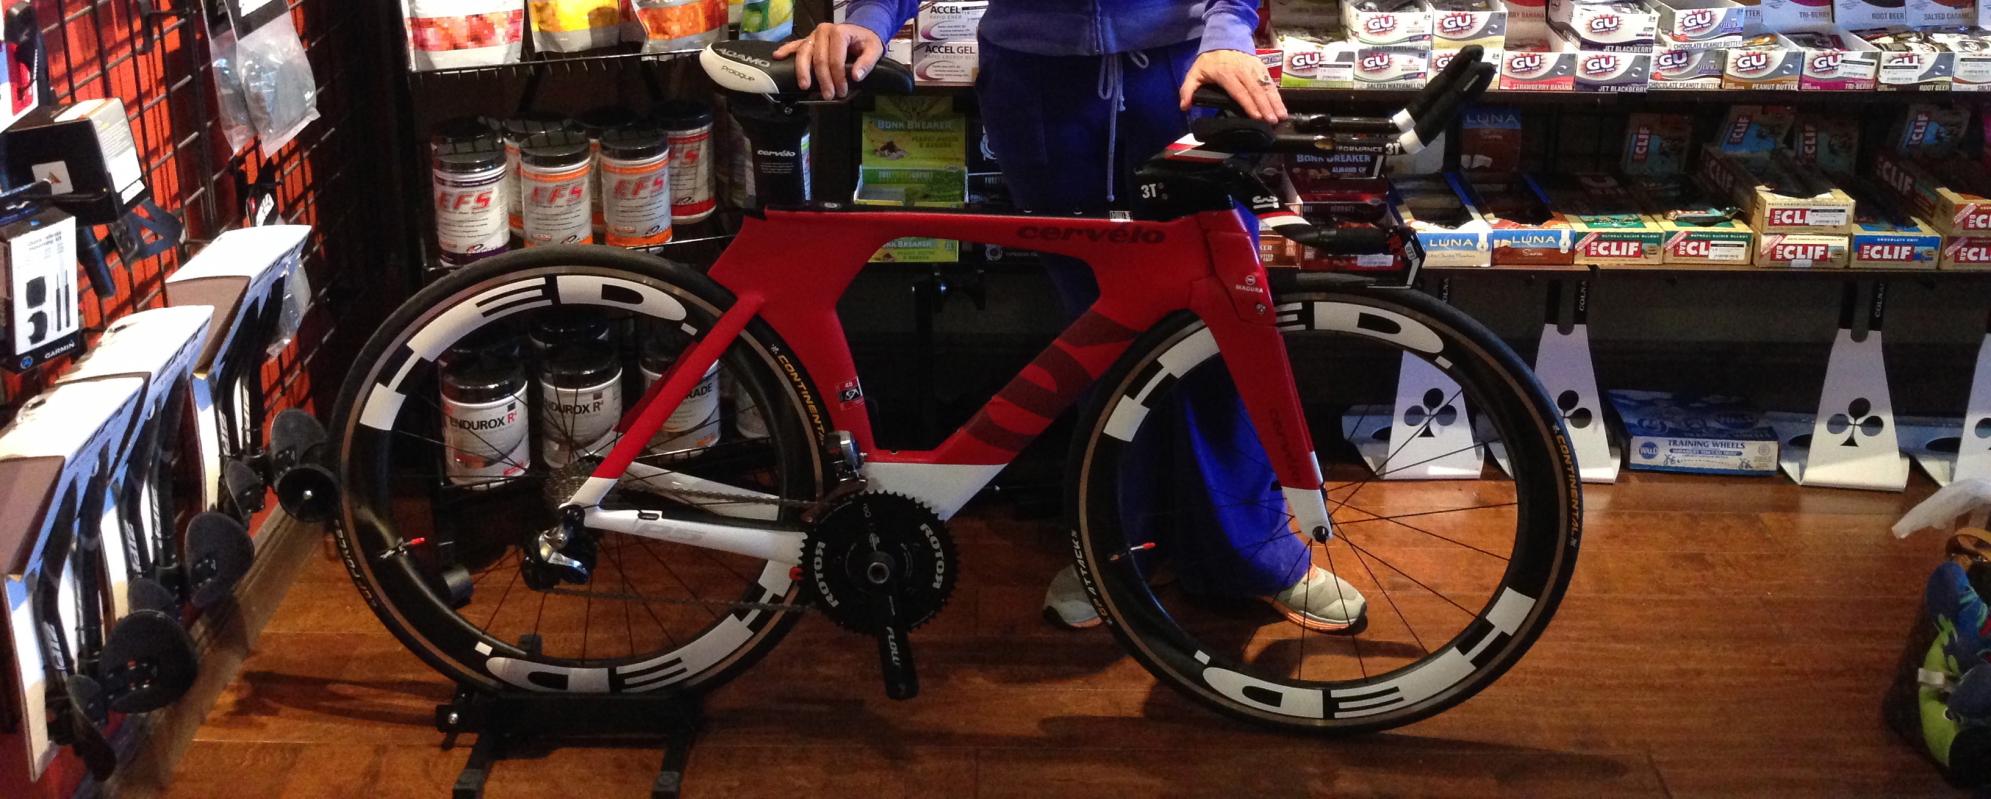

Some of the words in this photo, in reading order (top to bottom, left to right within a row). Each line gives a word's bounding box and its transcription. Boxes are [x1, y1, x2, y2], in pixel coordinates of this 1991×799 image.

[930, 6, 960, 14] ACCEL
[1745, 9, 1761, 17] TTER
[1889, 12, 1904, 20] BEER
[1366, 15, 1395, 31] GU
[1443, 14, 1472, 30] GU
[1591, 16, 1618, 30] GU
[1683, 12, 1712, 28] GU
[925, 45, 956, 54] ACCEL
[957, 46, 976, 55] GEL
[1614, 45, 1651, 53] BLACKBERRY
[1674, 42, 1701, 50] CHOCOLATE
[715, 47, 771, 68] ADAMO
[1291, 52, 1321, 67] GU
[1363, 53, 1390, 68] GU
[1512, 55, 1541, 70] GU
[1586, 57, 1616, 70] GU
[1658, 51, 1688, 66] GU
[1737, 54, 1766, 69] GU
[1813, 54, 1842, 69] GU
[1610, 85, 1647, 93] BLACKBERRY
[878, 119, 904, 129] BONK
[907, 119, 952, 129] BREAKER
[1466, 113, 1517, 124] LUNA
[1733, 116, 1750, 142] CLIF
[1912, 114, 1928, 140] CLIF
[1636, 127, 1650, 158] CLIF
[1805, 124, 1816, 154] CLIF
[1385, 142, 1400, 155] 3T
[1326, 154, 1371, 163] BREAKER
[531, 184, 584, 205] EFS
[613, 177, 664, 199] EFS
[1141, 183, 1157, 199] 3T
[437, 190, 494, 210] EFS
[1782, 211, 1811, 225] CLI
[1976, 214, 1991, 228] CL
[1017, 222, 1167, 245] cervélo
[1513, 235, 1555, 246] LUNA
[1430, 238, 1473, 248] LUNA
[1598, 242, 1639, 256] CLIF
[1687, 242, 1709, 256] CL
[1784, 246, 1826, 260] CLIF
[1871, 246, 1912, 260] CLIF
[1967, 247, 1991, 261] CL
[44, 341, 75, 359] GARMIN
[777, 354, 825, 443] CONTINENTA
[450, 417, 505, 431] ENDUROX
[1668, 439, 1709, 448] TRAINING
[1712, 440, 1746, 449] WHEELS
[920, 523, 945, 589] ROTOR
[814, 540, 840, 607] ROTOR
[886, 625, 901, 667] FLOW
